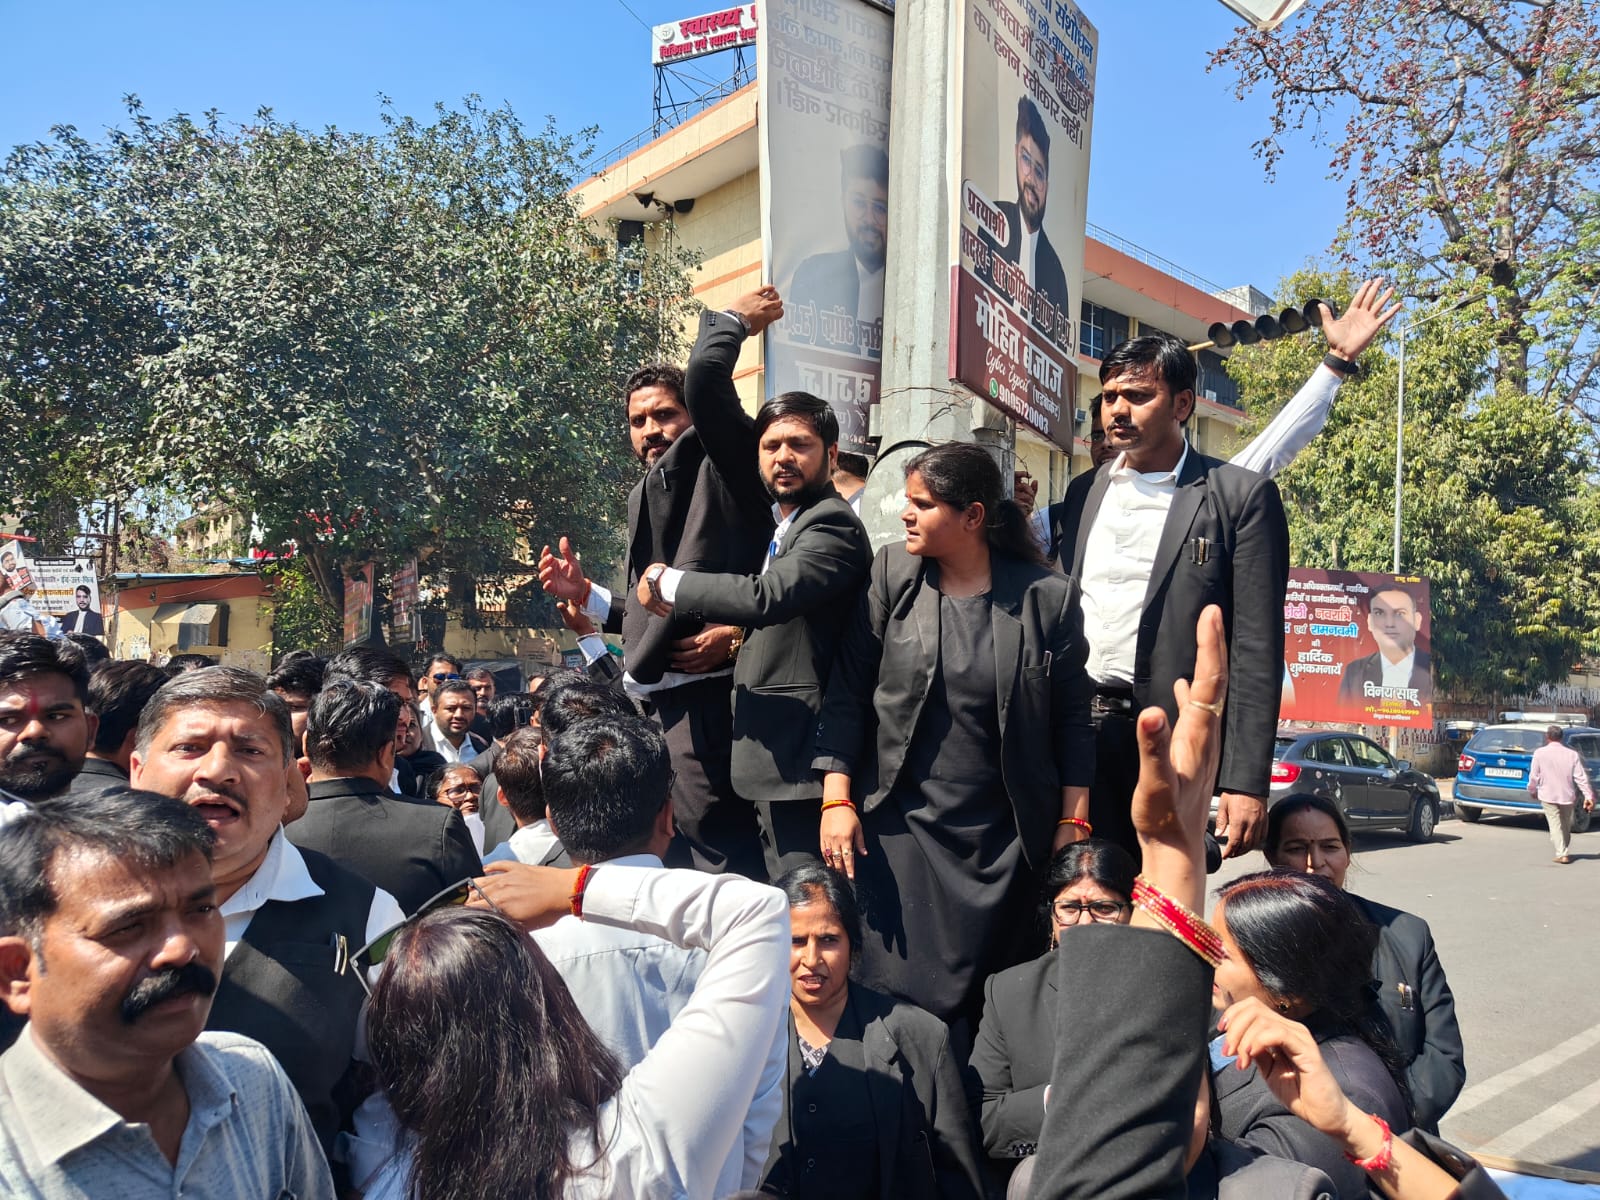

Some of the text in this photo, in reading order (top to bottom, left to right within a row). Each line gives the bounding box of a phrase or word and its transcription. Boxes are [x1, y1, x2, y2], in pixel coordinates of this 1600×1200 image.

[1055, 2, 1093, 64] संशोधन
[973, 4, 991, 42] का
[994, 29, 1021, 77] हनन
[1023, 63, 1060, 123] स्वीकार
[968, 186, 1006, 243] प्रत्याशी
[975, 291, 1064, 399] मोहित बजाज
[1309, 622, 1358, 639] रामनवमी
[1315, 606, 1352, 622] नवरात्रि
[1297, 649, 1334, 663] हार्दिक
[1363, 681, 1421, 707] विनय साहू
